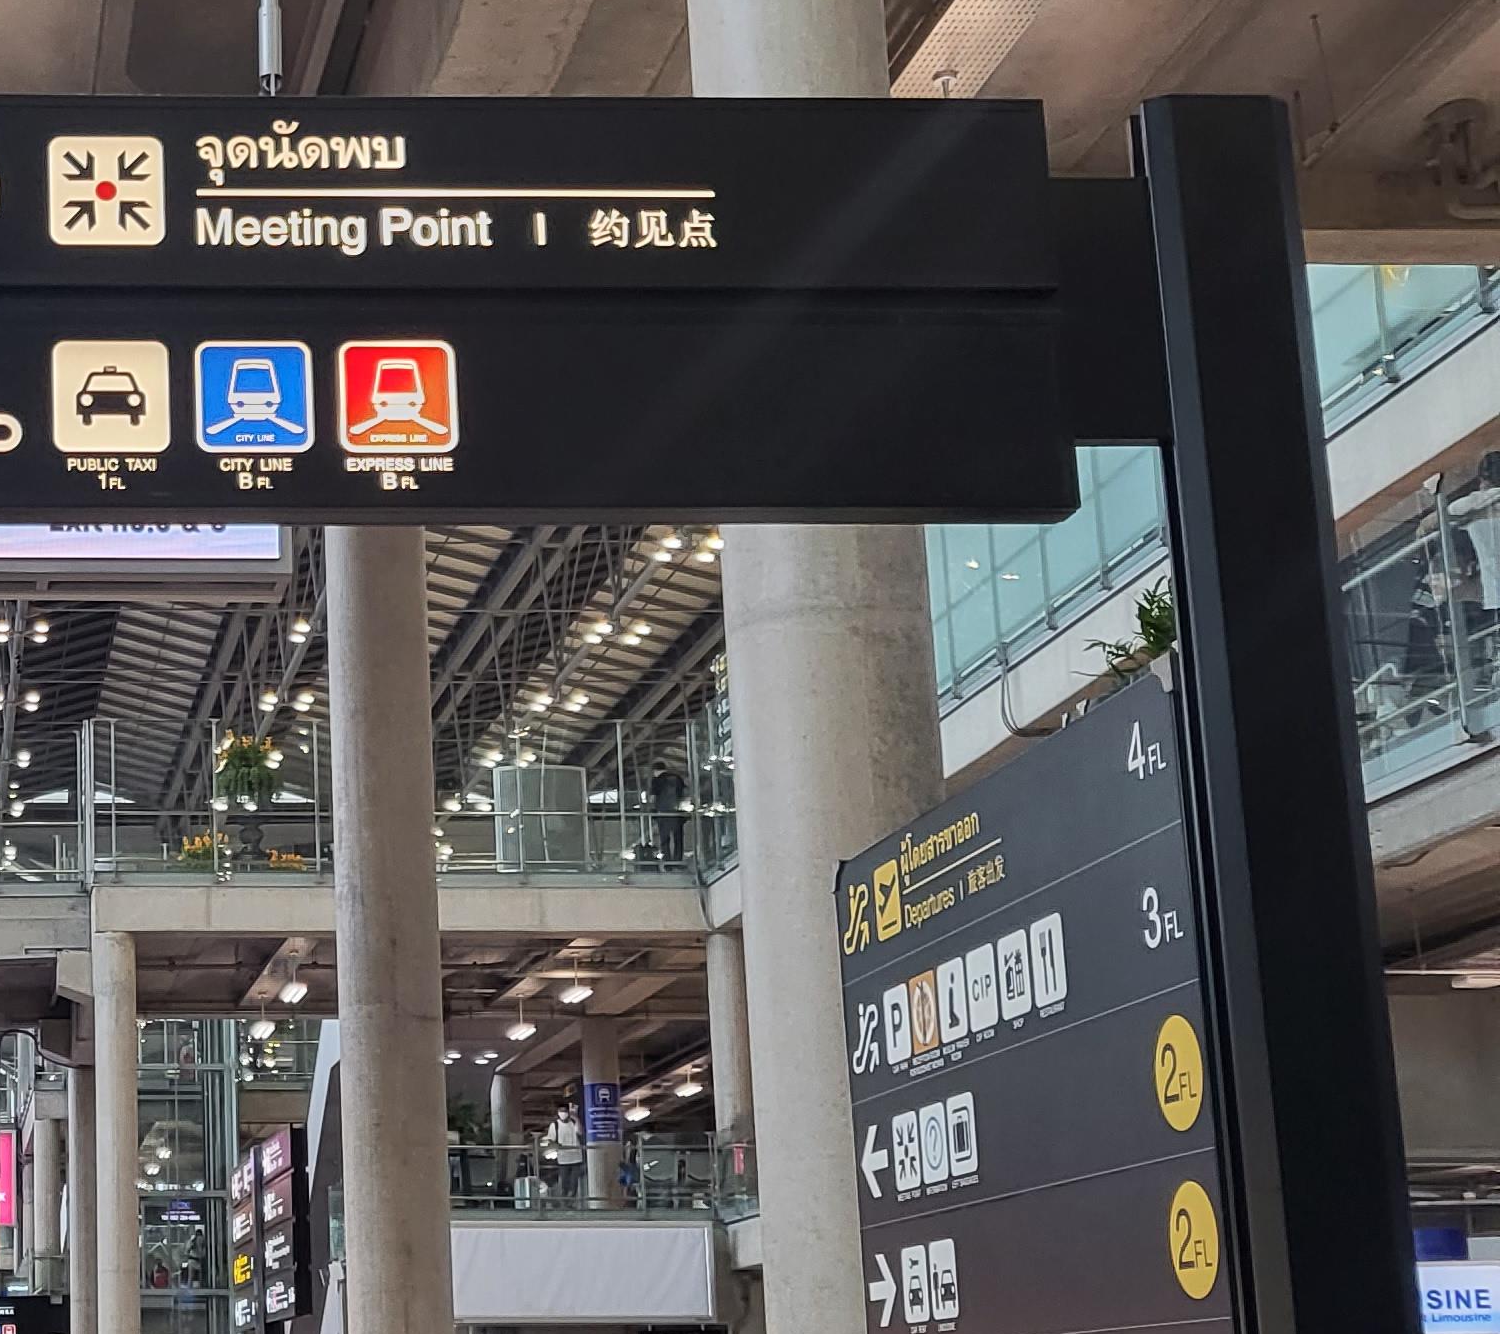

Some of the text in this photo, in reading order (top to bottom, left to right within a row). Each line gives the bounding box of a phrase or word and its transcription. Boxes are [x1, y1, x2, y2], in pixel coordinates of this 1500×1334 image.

[196, 120, 406, 187] จุดนัดพบ
[196, 208, 493, 255] Meeting Point
[588, 207, 718, 248] 约见点
[235, 434, 275, 443] CITY LINE
[66, 457, 158, 472] PUBLIC TAXI
[219, 457, 293, 472] CITY LINE
[346, 457, 454, 472] EXPRESS LINE
[904, 886, 955, 928] Departures
[972, 974, 992, 1002] CIP
[1432, 1313, 1492, 1323] Limousine
